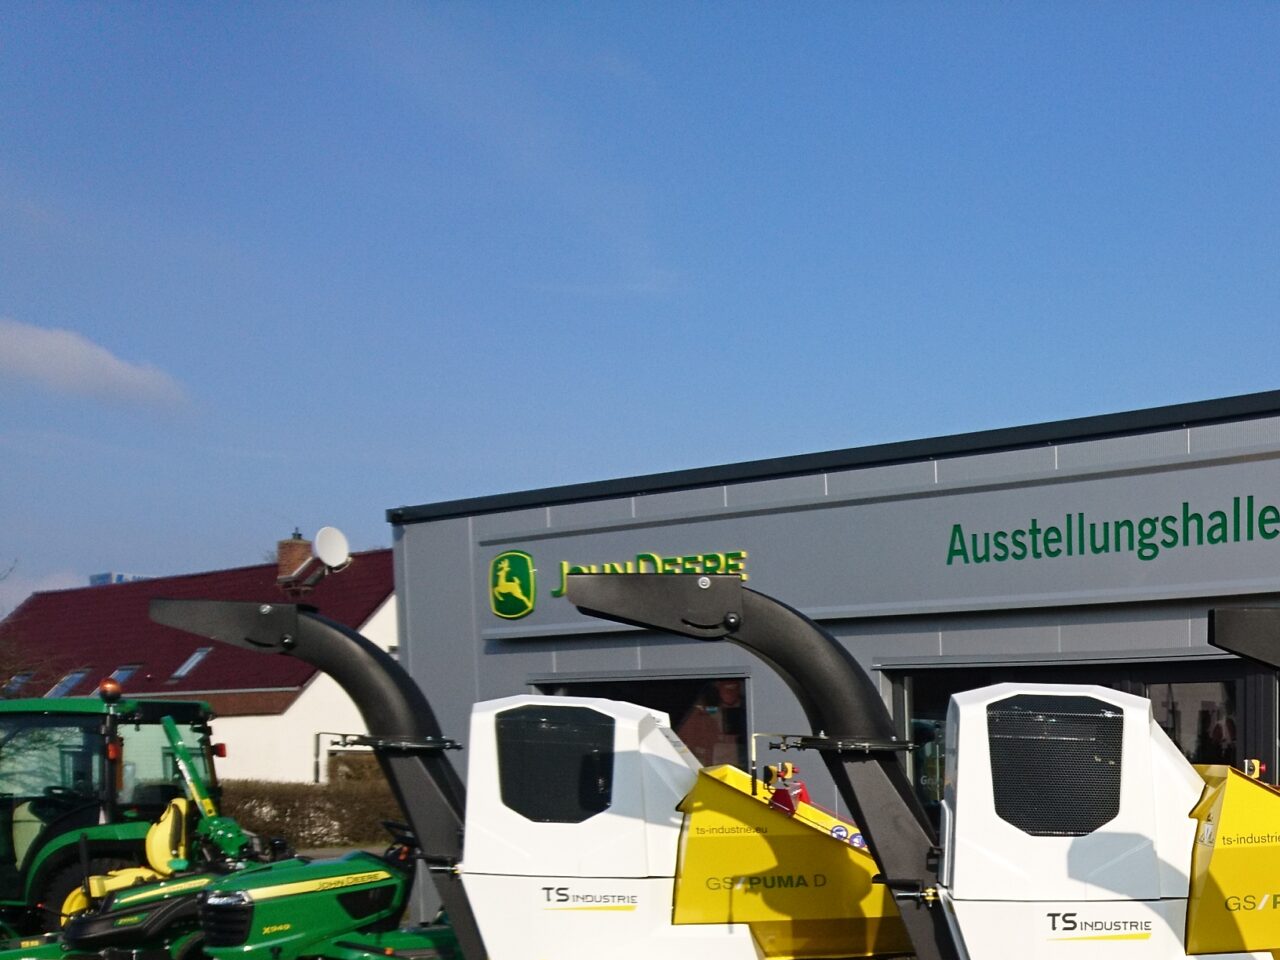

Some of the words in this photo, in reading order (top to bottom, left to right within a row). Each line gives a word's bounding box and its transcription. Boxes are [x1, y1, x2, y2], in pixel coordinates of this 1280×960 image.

[946, 495, 1280, 566] Ausstellungshalle
[696, 824, 768, 835] ts-industrie.eu
[541, 887, 570, 902] TS
[572, 894, 638, 903] INDUSTRIE
[1046, 912, 1077, 931] TS
[1080, 921, 1152, 931] INDUSTRIE
